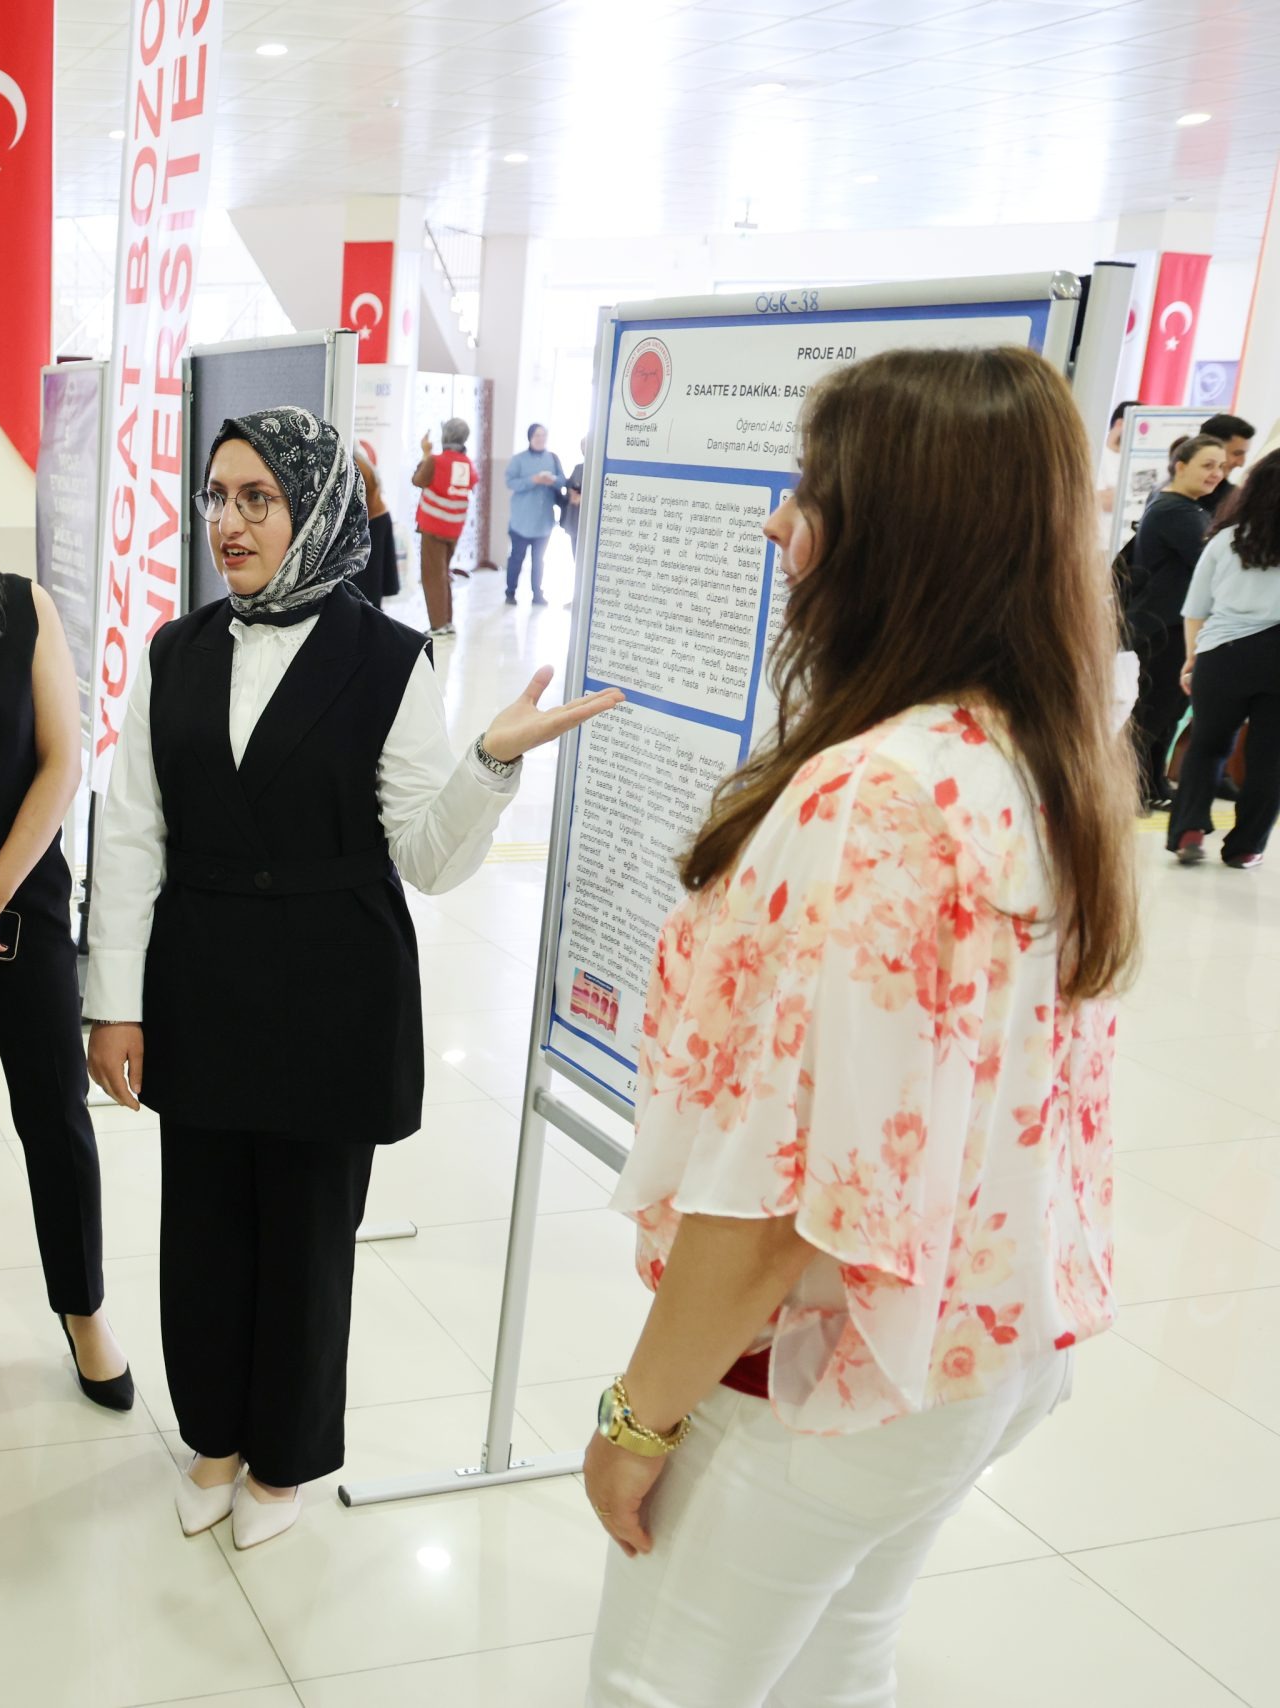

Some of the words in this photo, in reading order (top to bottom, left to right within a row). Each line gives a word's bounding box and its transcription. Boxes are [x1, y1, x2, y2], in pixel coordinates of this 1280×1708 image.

[797, 347, 835, 360] PROJE
[836, 346, 856, 359] ADI
[686, 384, 693, 396] 2
[694, 384, 729, 397] SAATTE
[731, 385, 738, 397] 2
[740, 382, 781, 398] DAKİKA:
[624, 422, 658, 434] Hemşirelik
[736, 418, 769, 433] Öğrenci
[769, 421, 784, 432] Adı
[626, 436, 650, 448] Bölümü
[706, 438, 746, 454] Danışman
[747, 440, 761, 452] Adı
[96, 345, 141, 759] YOZGAT
